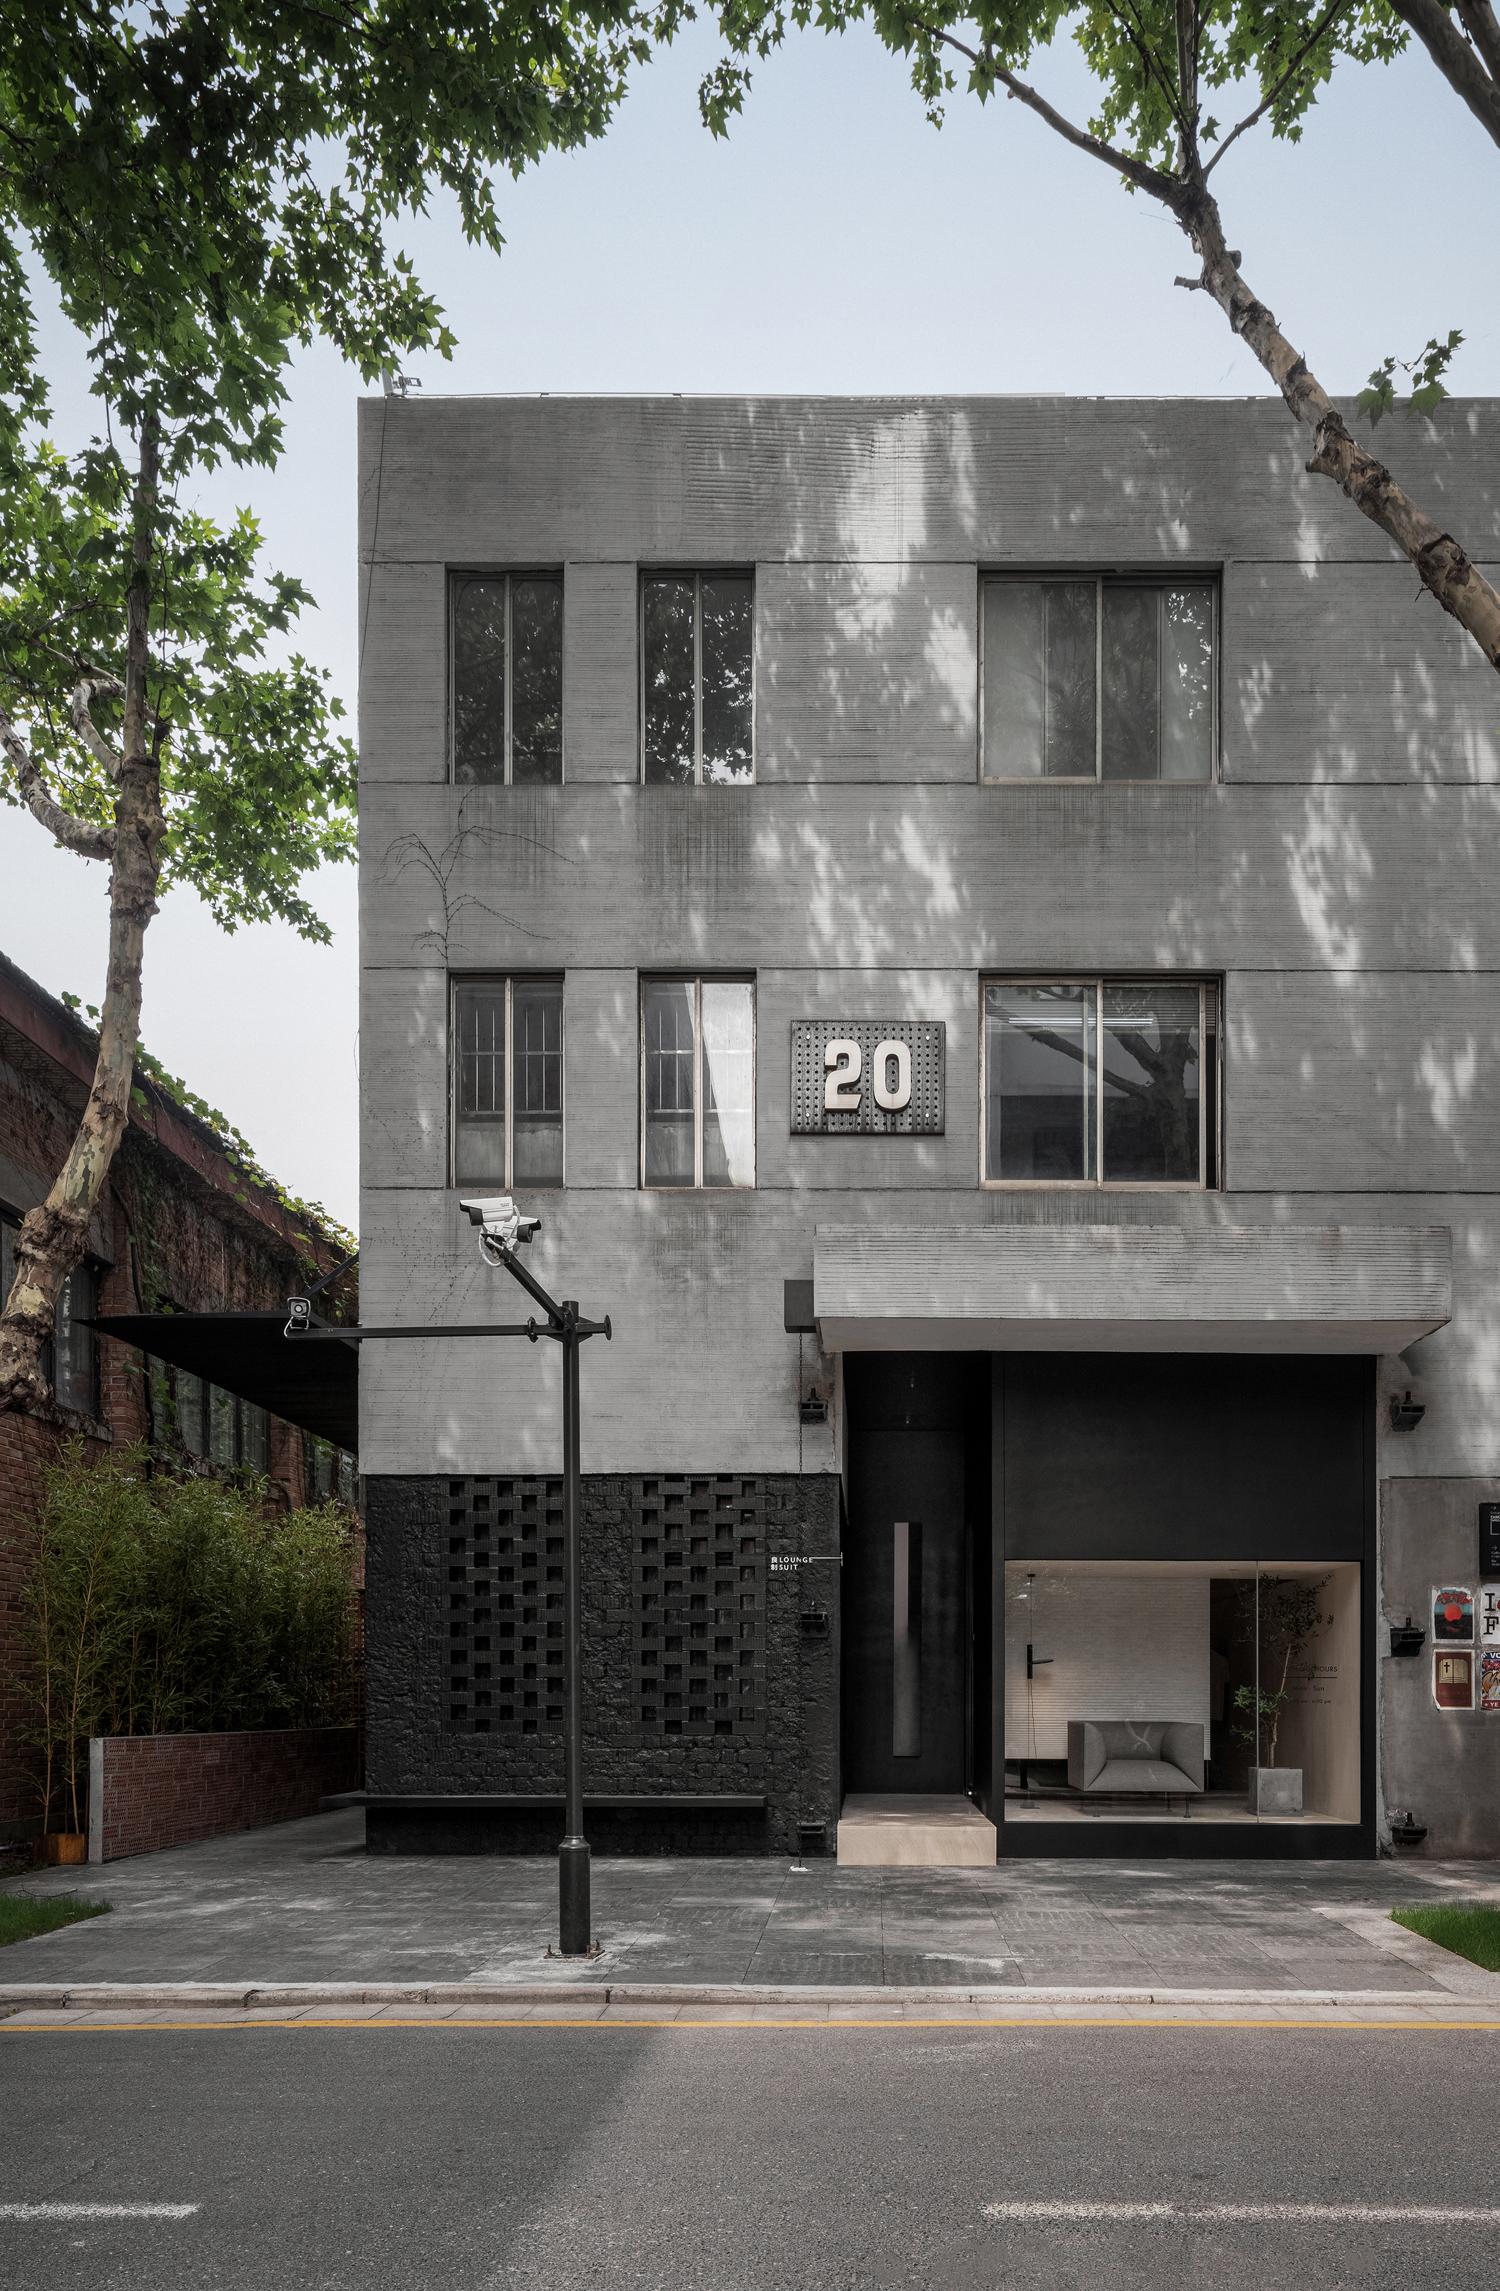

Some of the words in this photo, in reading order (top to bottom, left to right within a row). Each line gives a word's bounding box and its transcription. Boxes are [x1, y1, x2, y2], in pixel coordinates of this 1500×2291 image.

[824, 1039, 912, 1109] 20
[779, 1556, 813, 1564] LOUNGE
[778, 1563, 798, 1571] SUIT
